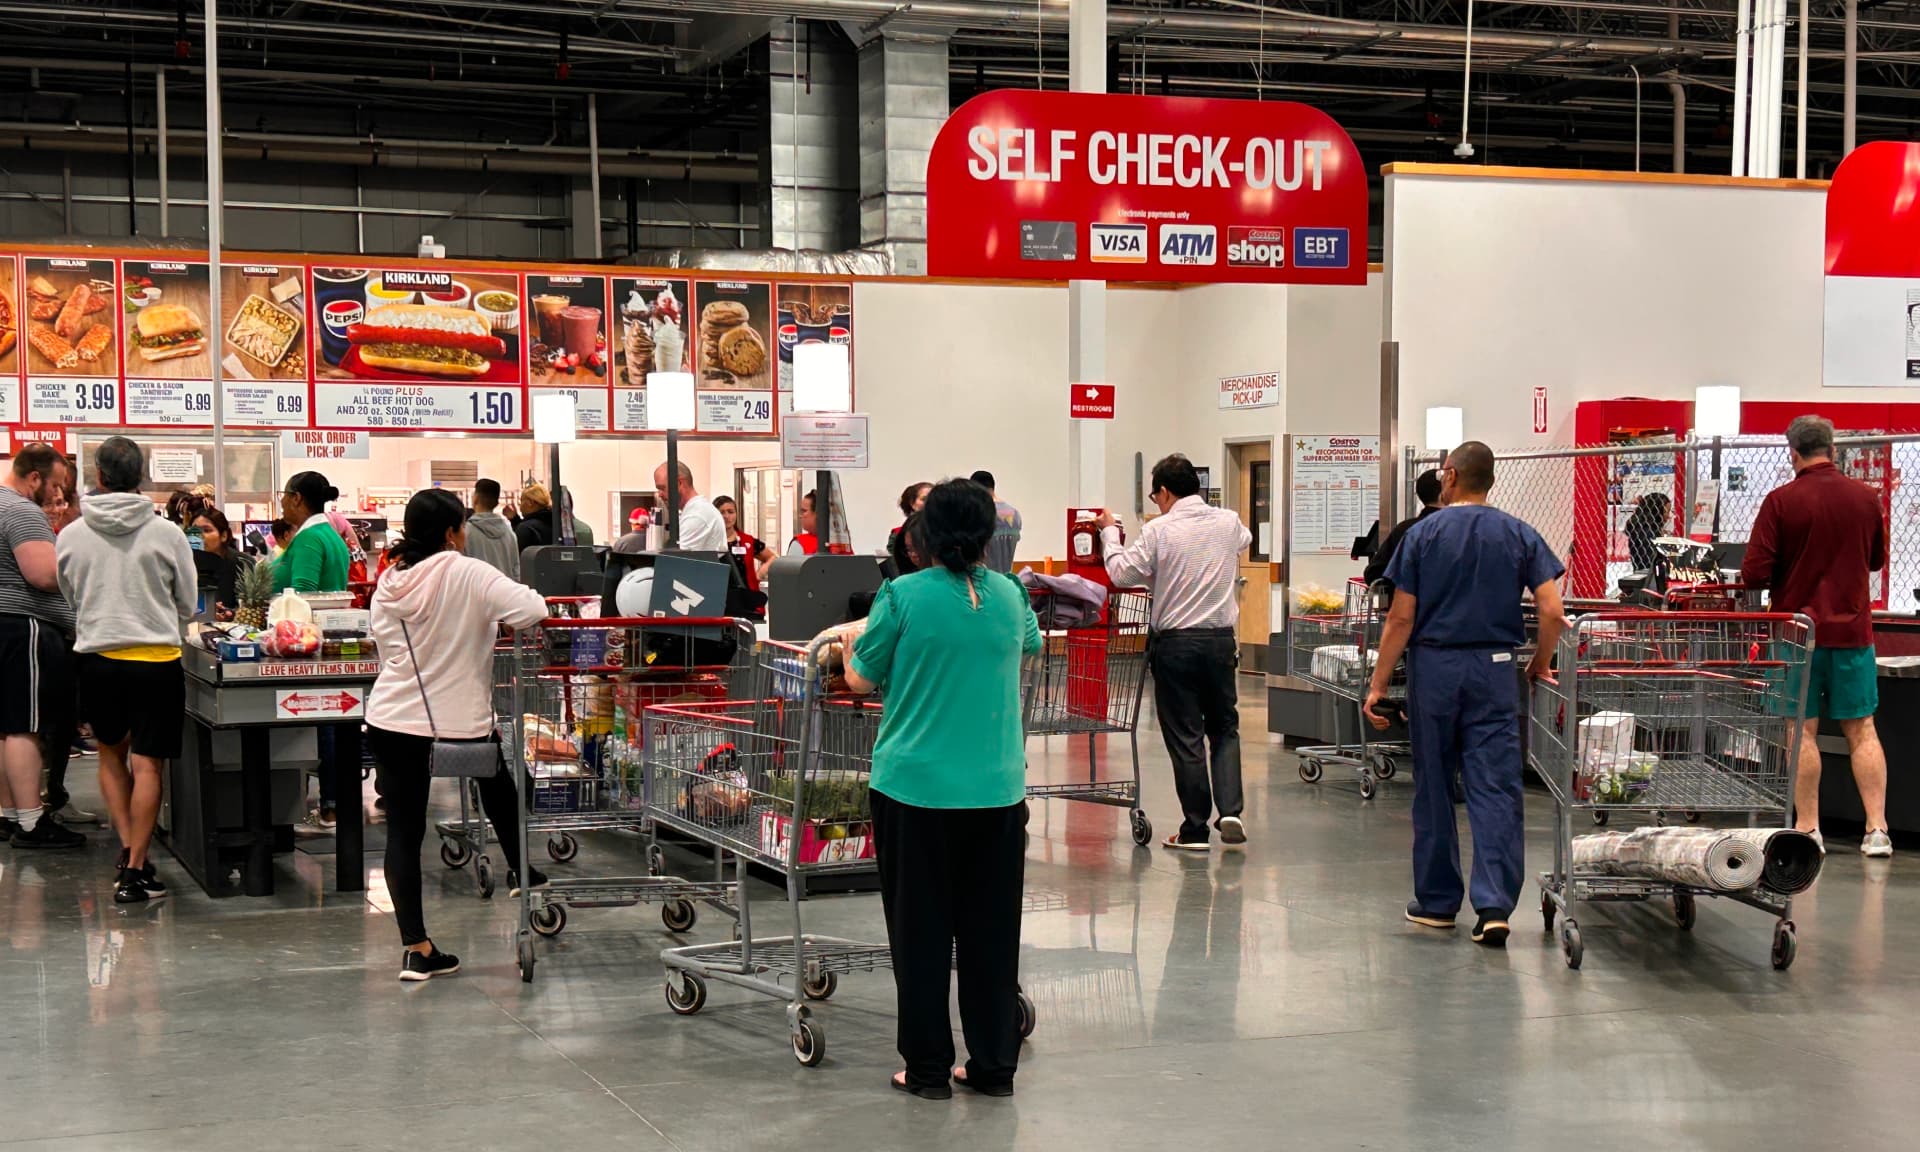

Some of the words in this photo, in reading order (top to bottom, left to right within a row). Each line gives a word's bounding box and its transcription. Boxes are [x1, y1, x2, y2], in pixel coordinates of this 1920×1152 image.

[968, 125, 1076, 182] SELF
[1088, 130, 1331, 191] CHECK-OUT
[1100, 234, 1140, 252] VISA
[1162, 234, 1214, 256] ATM
[1304, 236, 1338, 254] EBT
[1228, 240, 1284, 268] shop
[385, 272, 450, 285] KIRKLAND
[326, 312, 362, 323] PEPSI
[780, 334, 798, 342] PEP
[1221, 374, 1276, 392] MERCHANDISE
[76, 384, 114, 410] 3.99
[396, 387, 423, 396] PLUS
[628, 392, 643, 403] 2.49
[1232, 391, 1262, 405] PICK-UP
[185, 393, 211, 411] 6.99
[277, 395, 302, 413] 6.99
[353, 396, 369, 404] ALL
[372, 396, 392, 405] BEEF
[396, 397, 413, 405] HOT
[416, 397, 434, 406] DOG
[336, 406, 355, 414] AND
[358, 406, 368, 415] 20
[386, 406, 410, 416] SODA
[470, 392, 513, 424] 1.50
[744, 400, 769, 419] 2.49
[410, 417, 424, 426] cal.
[41, 431, 61, 440] PIZZA
[295, 432, 323, 444] KIOSK
[327, 432, 356, 444] ORDER
[306, 446, 345, 458] PICK-UP
[260, 664, 286, 675] LEAVE
[288, 664, 314, 674] HEAVY
[317, 664, 342, 674] ITEMS
[345, 663, 356, 673] ON
[358, 662, 378, 673] CART
